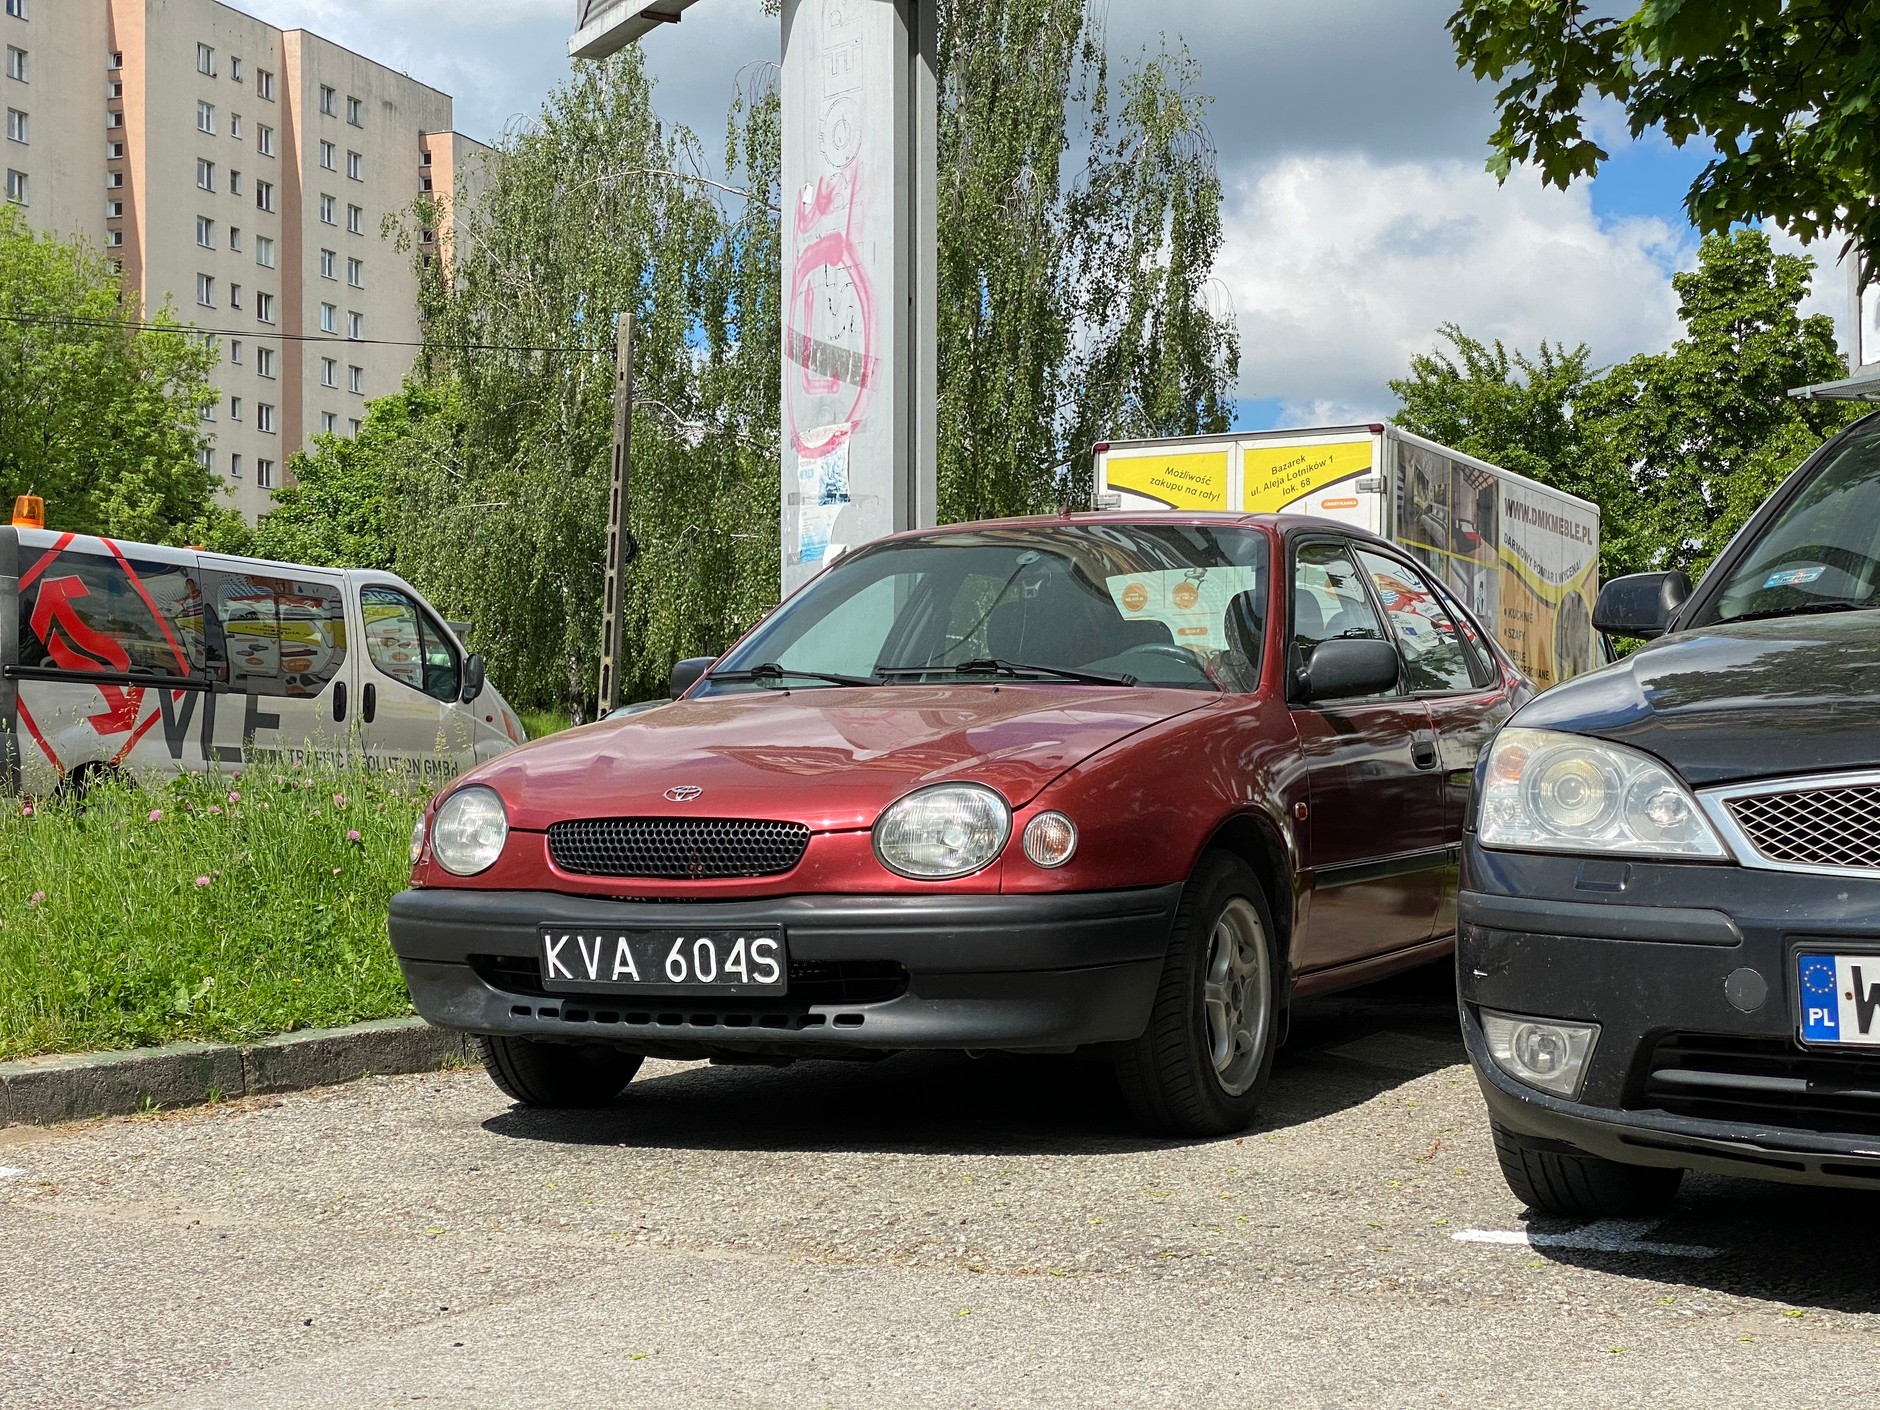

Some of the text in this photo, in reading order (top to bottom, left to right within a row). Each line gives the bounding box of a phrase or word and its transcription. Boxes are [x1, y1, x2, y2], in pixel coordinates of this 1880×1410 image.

[1271, 454, 1306, 475] Bazarek
[1164, 466, 1212, 486] Możliwość
[1250, 455, 1334, 497] ul. Aleja Lotników 1
[1149, 477, 1184, 492] zakupu
[1184, 487, 1198, 496] na
[1282, 477, 1311, 496] lok. 68
[1504, 497, 1593, 546] WWW.DMKMEBLE.PL
[1503, 532, 1533, 567] DARMOWY
[1507, 607, 1533, 624] KUCHNIE
[1507, 628, 1526, 640] SZAFY
[361, 754, 420, 775] SOLUTON
[544, 934, 780, 984] KVA 604S
[1808, 1007, 1835, 1027] PL
